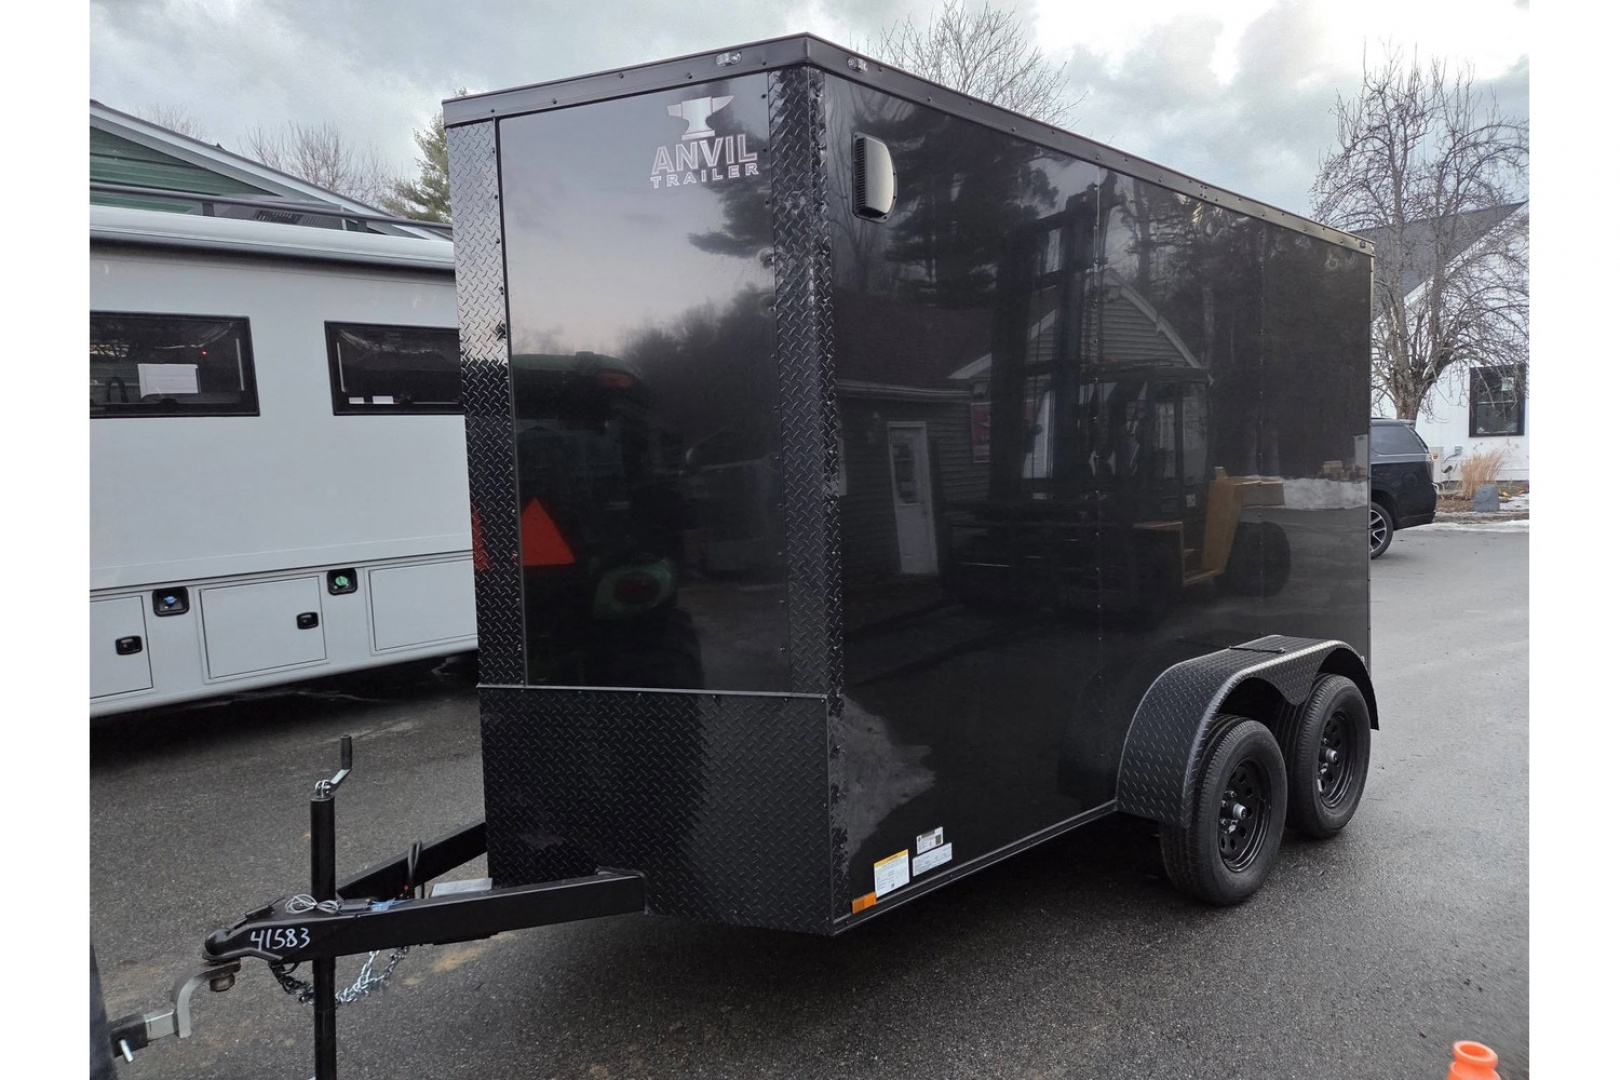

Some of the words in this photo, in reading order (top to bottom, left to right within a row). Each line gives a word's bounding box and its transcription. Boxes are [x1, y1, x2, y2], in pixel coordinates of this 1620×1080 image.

[651, 134, 758, 175] ANVIL
[650, 163, 759, 188] TRAILER
[250, 928, 311, 952] 41583
